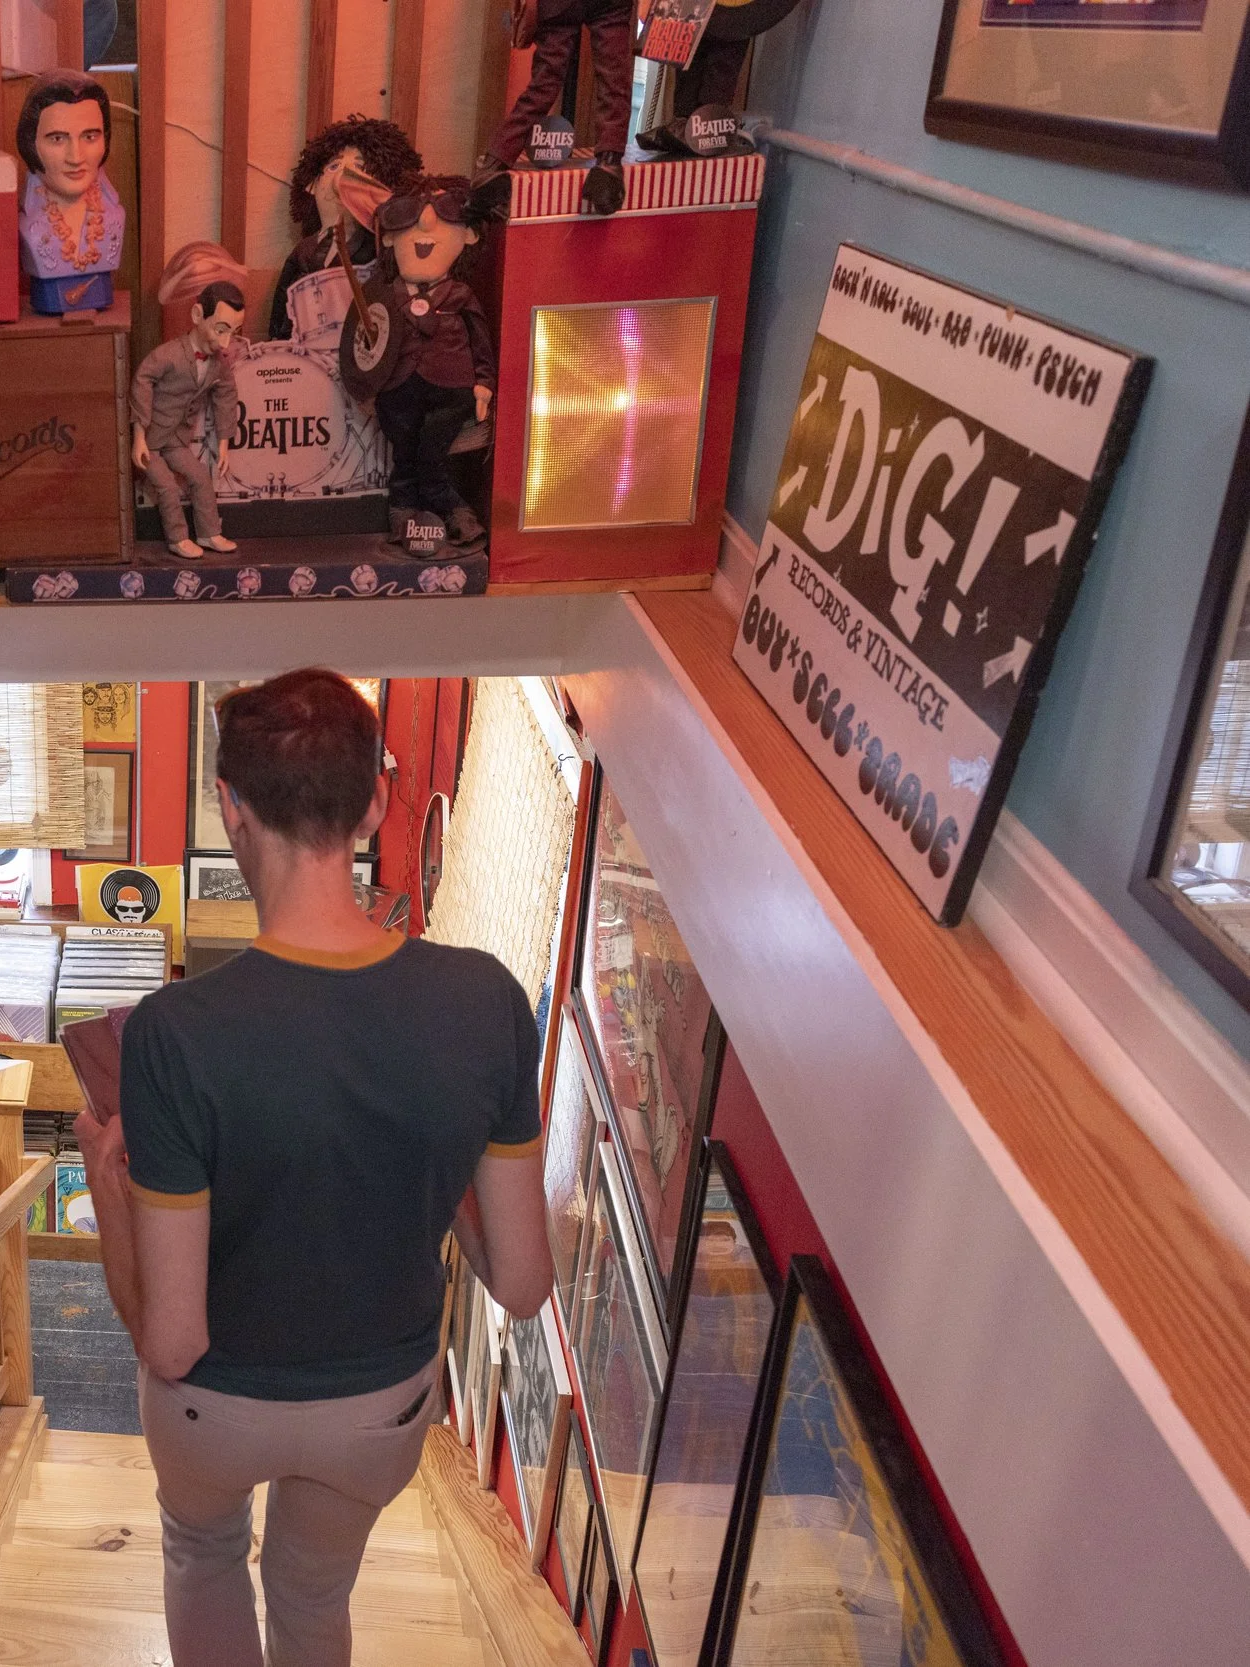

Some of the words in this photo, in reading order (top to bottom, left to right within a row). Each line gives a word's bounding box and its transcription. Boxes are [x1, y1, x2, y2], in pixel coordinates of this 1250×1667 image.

[648, 17, 696, 43] BEATLES
[642, 39, 691, 63] FOREVER
[531, 124, 574, 149] BEATLES
[691, 115, 737, 138] BEATLES
[698, 136, 727, 149] FOREVER
[534, 149, 562, 160] FOREVER
[832, 264, 861, 299] ROCK
[902, 296, 934, 335] SOUL
[978, 323, 1029, 371] PUNK
[1033, 344, 1102, 407] PSYCH
[264, 398, 289, 412] THE
[228, 400, 331, 455] BEATLES
[406, 519, 444, 540] BEATLES
[409, 540, 435, 551] FOREVER
[787, 553, 851, 635] RECORDS
[846, 619, 863, 655] &
[864, 627, 949, 732] VINTAGE
